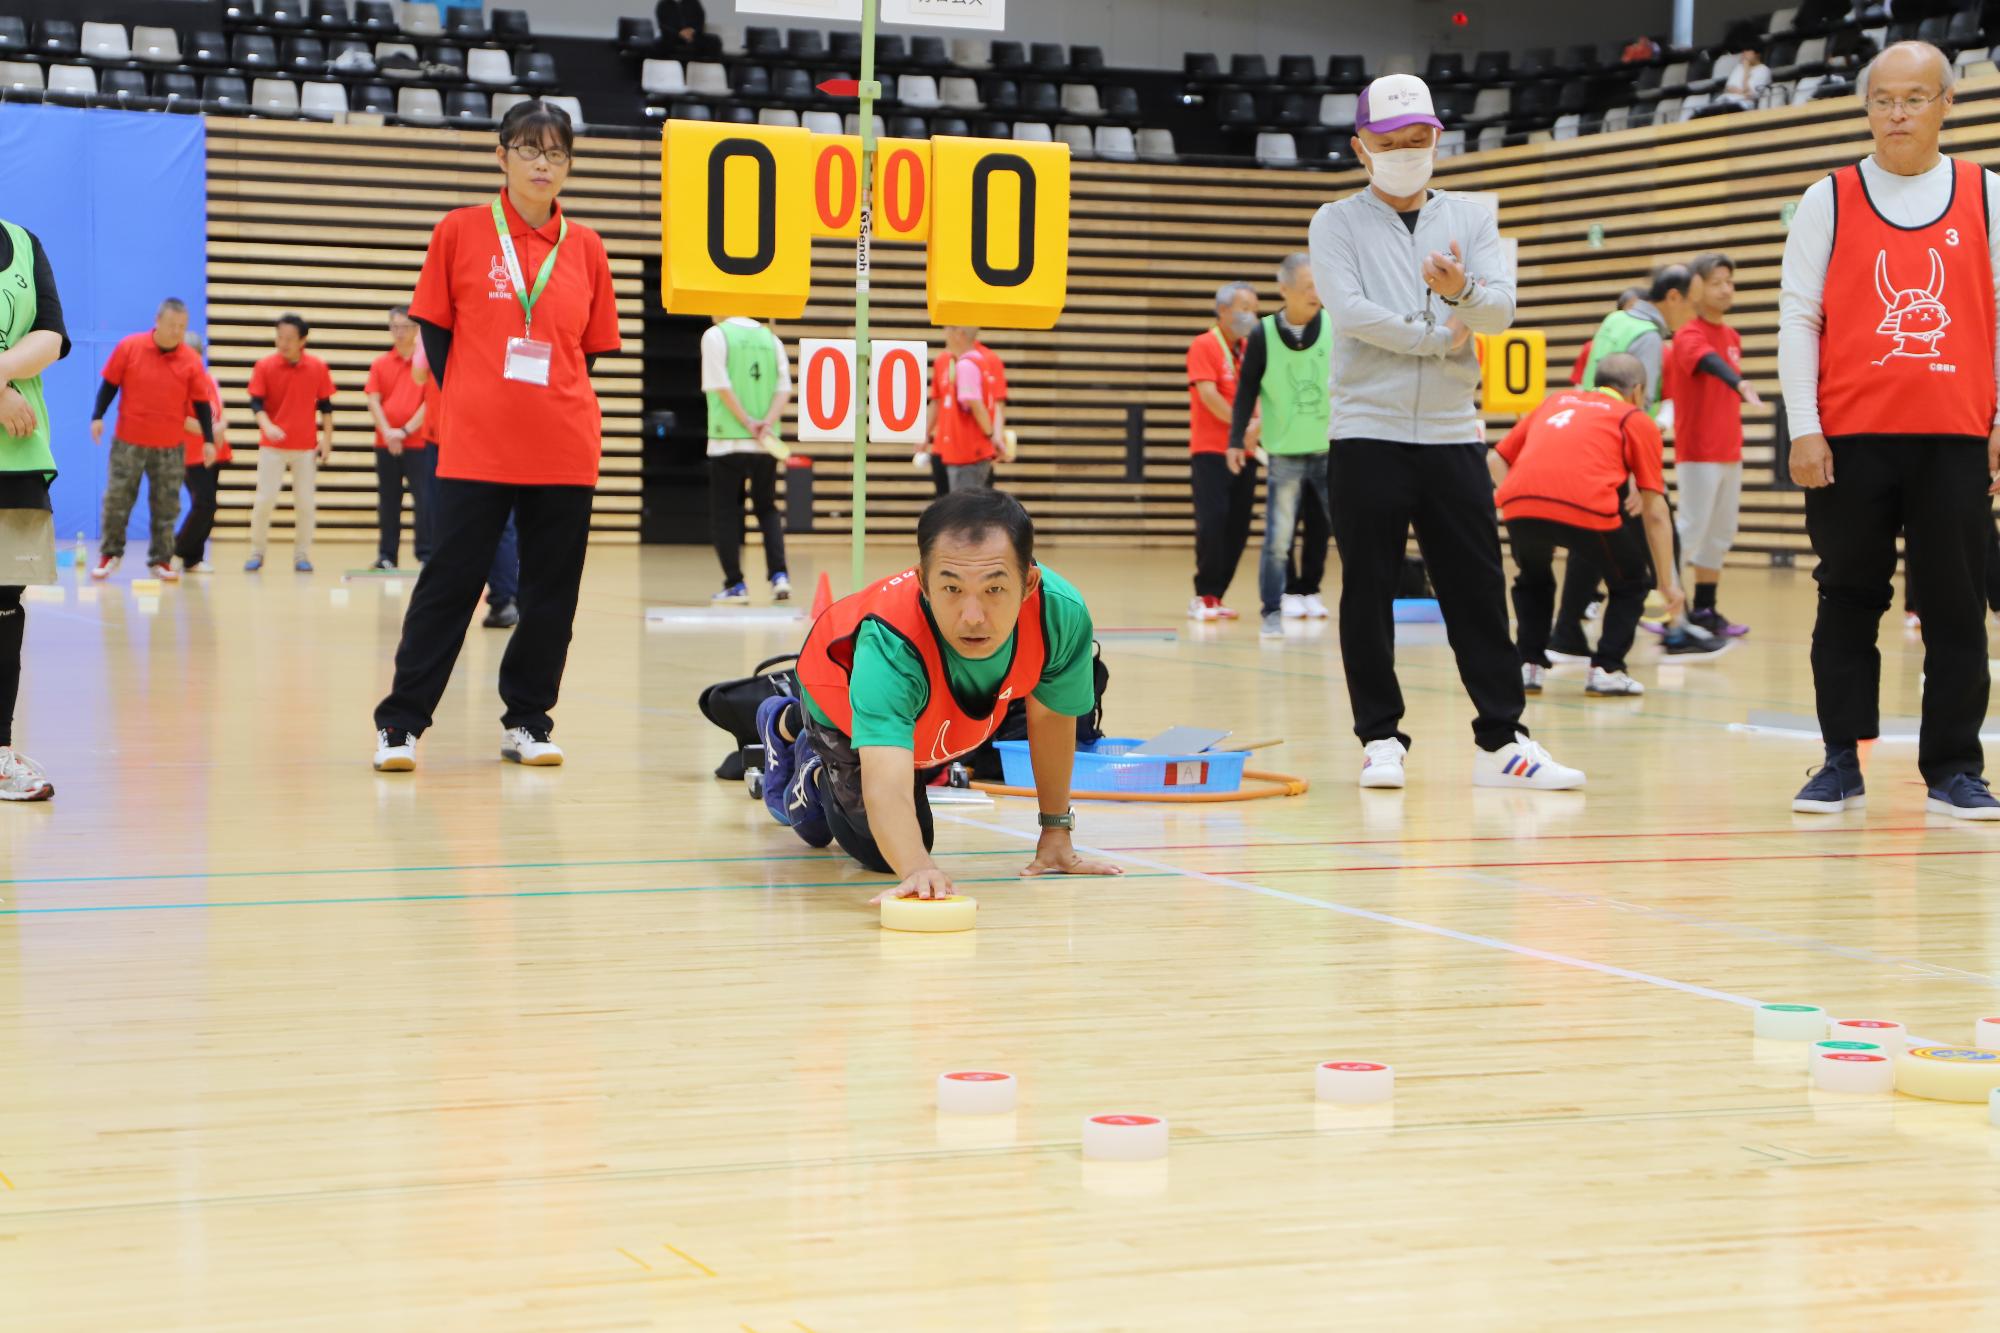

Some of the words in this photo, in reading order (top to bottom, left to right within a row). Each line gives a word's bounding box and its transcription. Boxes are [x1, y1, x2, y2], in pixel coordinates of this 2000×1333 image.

[707, 138, 776, 275] 0
[815, 144, 857, 230] 0
[884, 148, 925, 233] 0
[971, 152, 1036, 288] 0
[1945, 228, 1959, 246] 3
[858, 224, 868, 272] Senoh
[15, 274, 27, 289] 3
[749, 361, 761, 381] 4
[1504, 338, 1530, 395] 0
[806, 346, 850, 431] 0
[878, 348, 921, 432] 0
[1546, 408, 1575, 429] 4
[1184, 767, 1194, 780] A
